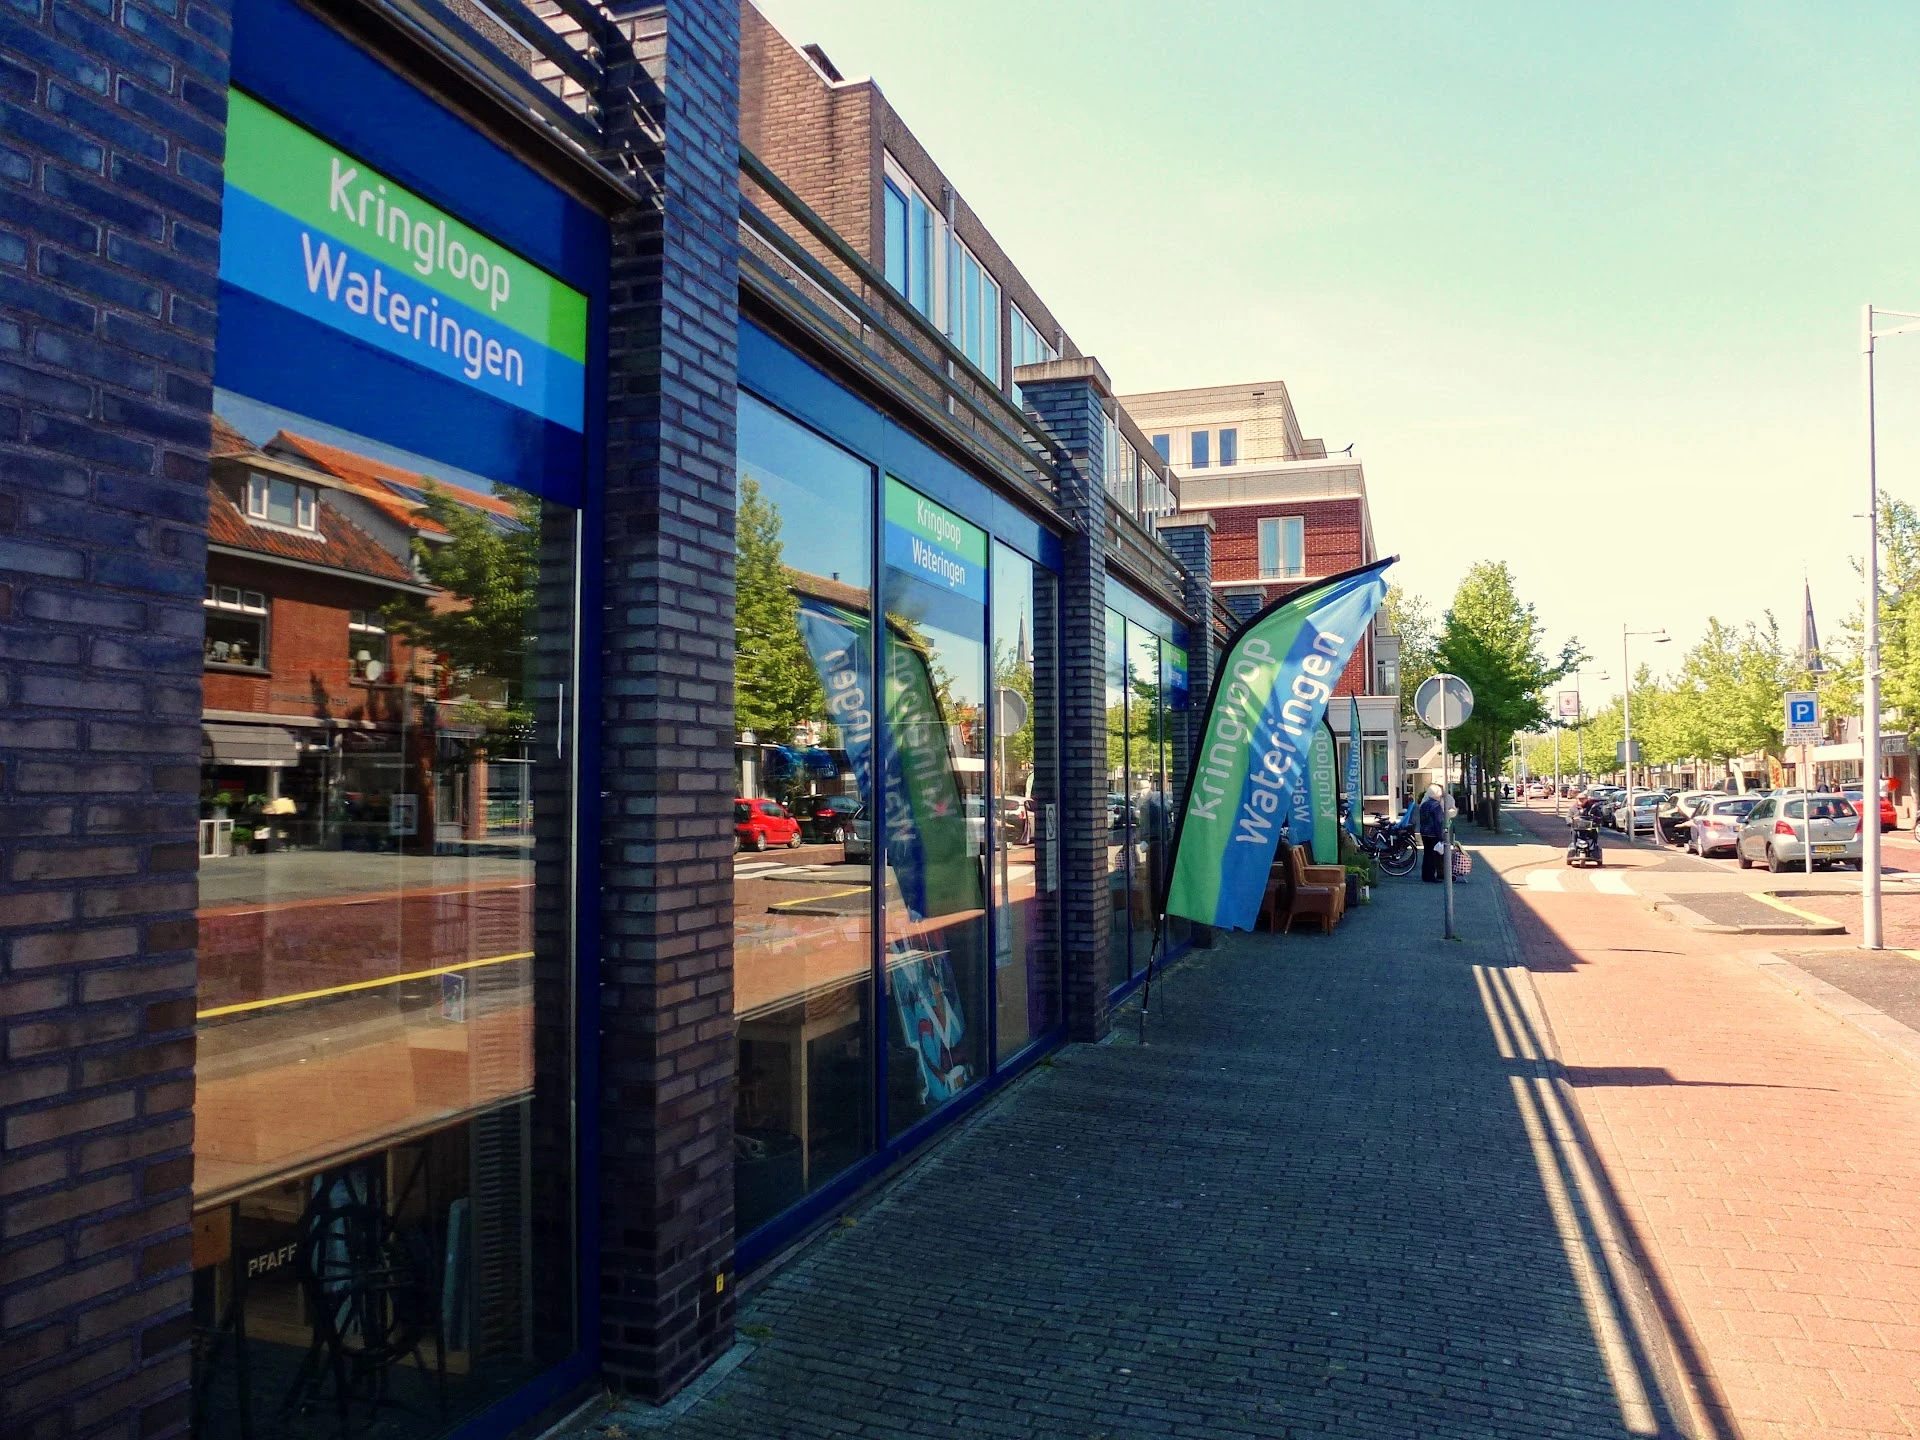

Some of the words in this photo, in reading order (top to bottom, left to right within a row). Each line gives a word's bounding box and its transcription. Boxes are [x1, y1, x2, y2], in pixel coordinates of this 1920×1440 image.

[330, 157, 510, 312] Kringloop
[302, 232, 524, 387] Wateringen
[912, 537, 965, 587] Wateringen
[917, 498, 961, 551] Kringloop
[1190, 637, 1276, 820] Kringloop
[1235, 631, 1345, 844] Wateringen
[1796, 703, 1810, 721] P
[248, 1242, 297, 1278] PFAFF
